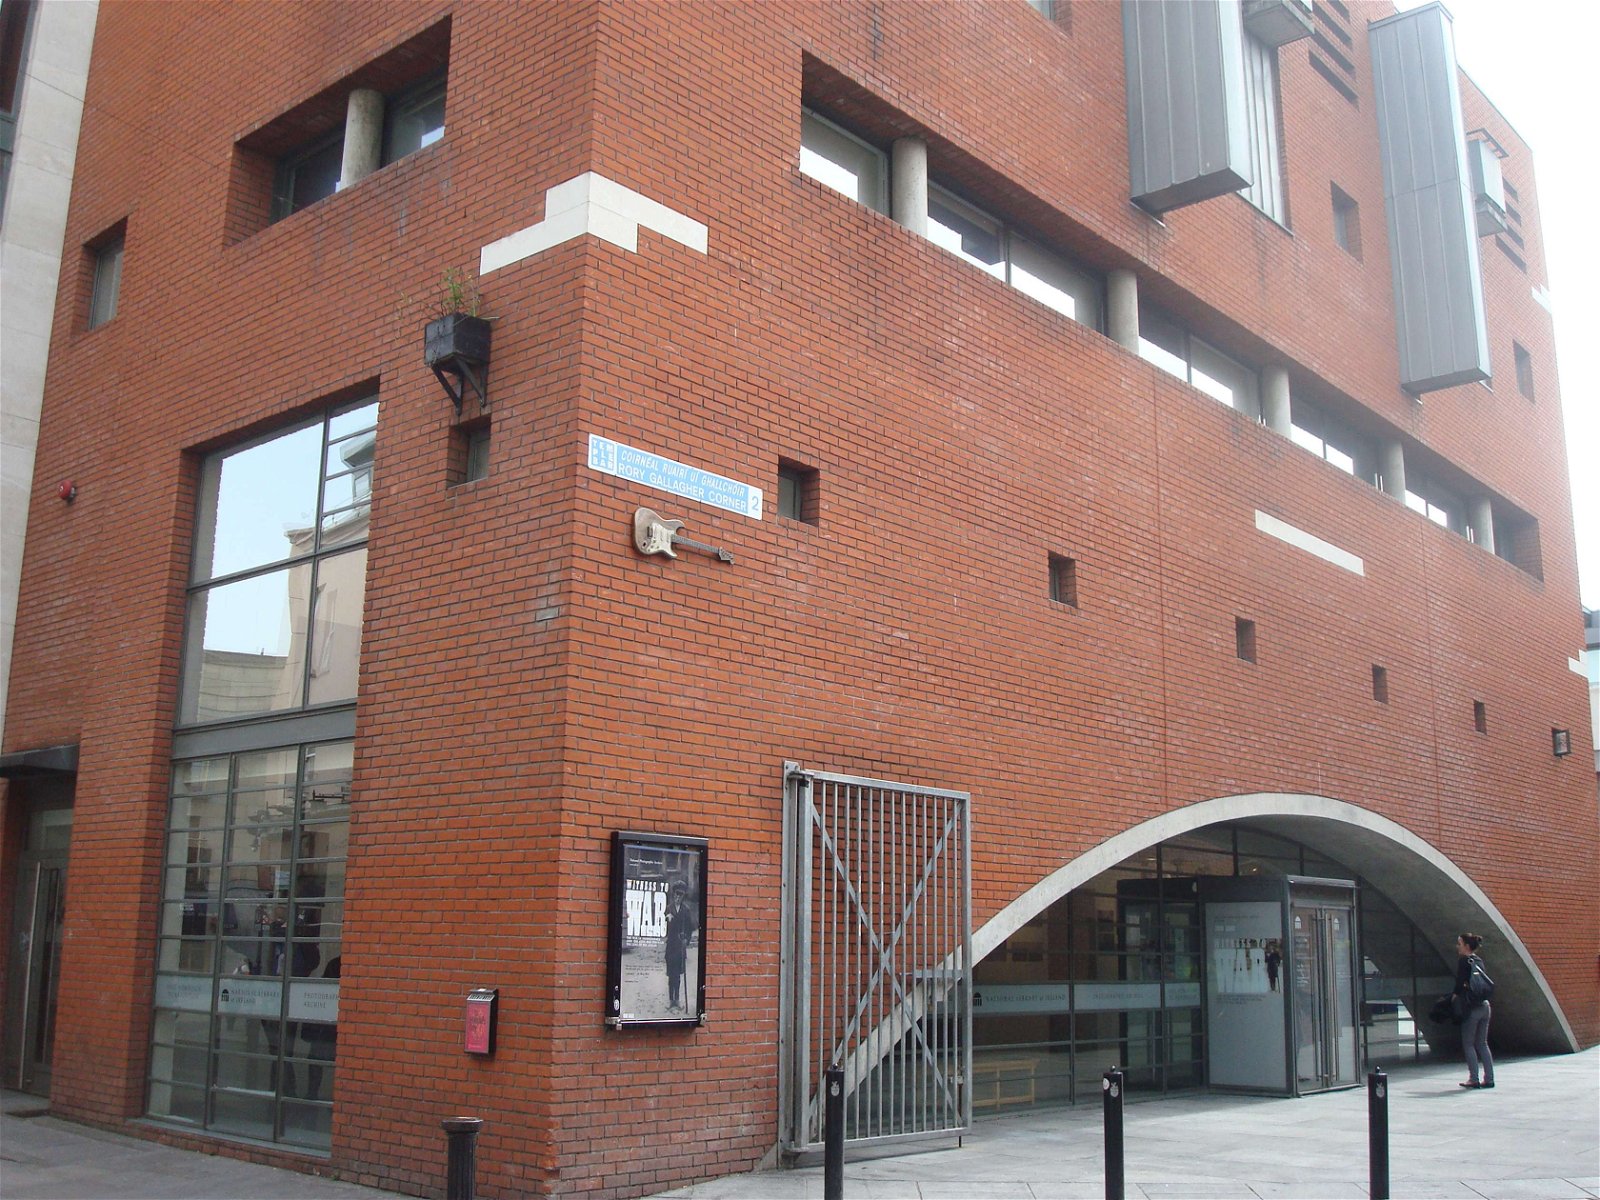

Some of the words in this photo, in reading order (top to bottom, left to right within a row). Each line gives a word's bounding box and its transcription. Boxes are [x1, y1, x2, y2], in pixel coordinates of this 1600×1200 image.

[618, 464, 645, 480] RORY
[649, 473, 705, 499] GALLAGHER
[708, 491, 747, 512] CORNER
[621, 450, 659, 471] COIRNÉAL
[662, 462, 687, 480] RUAIRÍ
[690, 471, 699, 482] UÍ
[701, 473, 745, 497] GHALLCHÓIR
[751, 495, 759, 511] 2
[626, 879, 657, 891] WITNESS
[660, 882, 669, 893] TO
[625, 889, 668, 937] WAR
